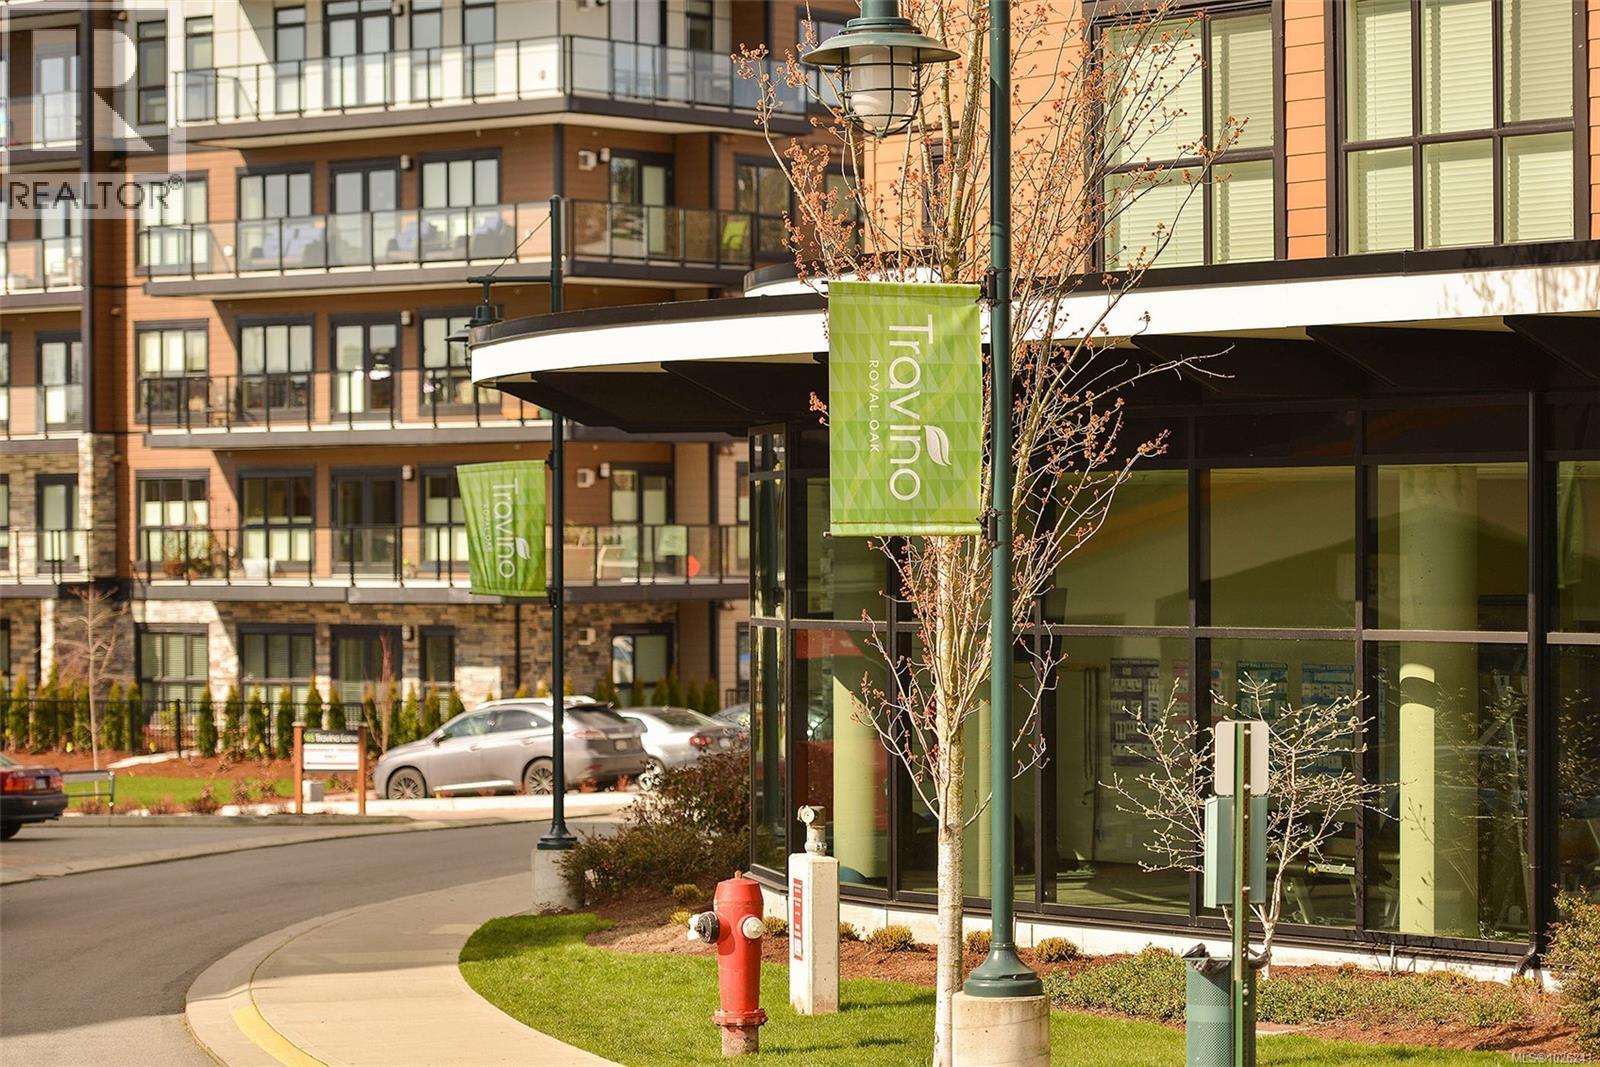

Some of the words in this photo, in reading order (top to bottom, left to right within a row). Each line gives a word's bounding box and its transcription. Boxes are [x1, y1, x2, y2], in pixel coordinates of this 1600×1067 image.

[869, 359, 880, 411] ROYAL
[888, 313, 934, 501] Travino
[869, 419, 880, 453] OAK
[492, 478, 518, 578] Travino
